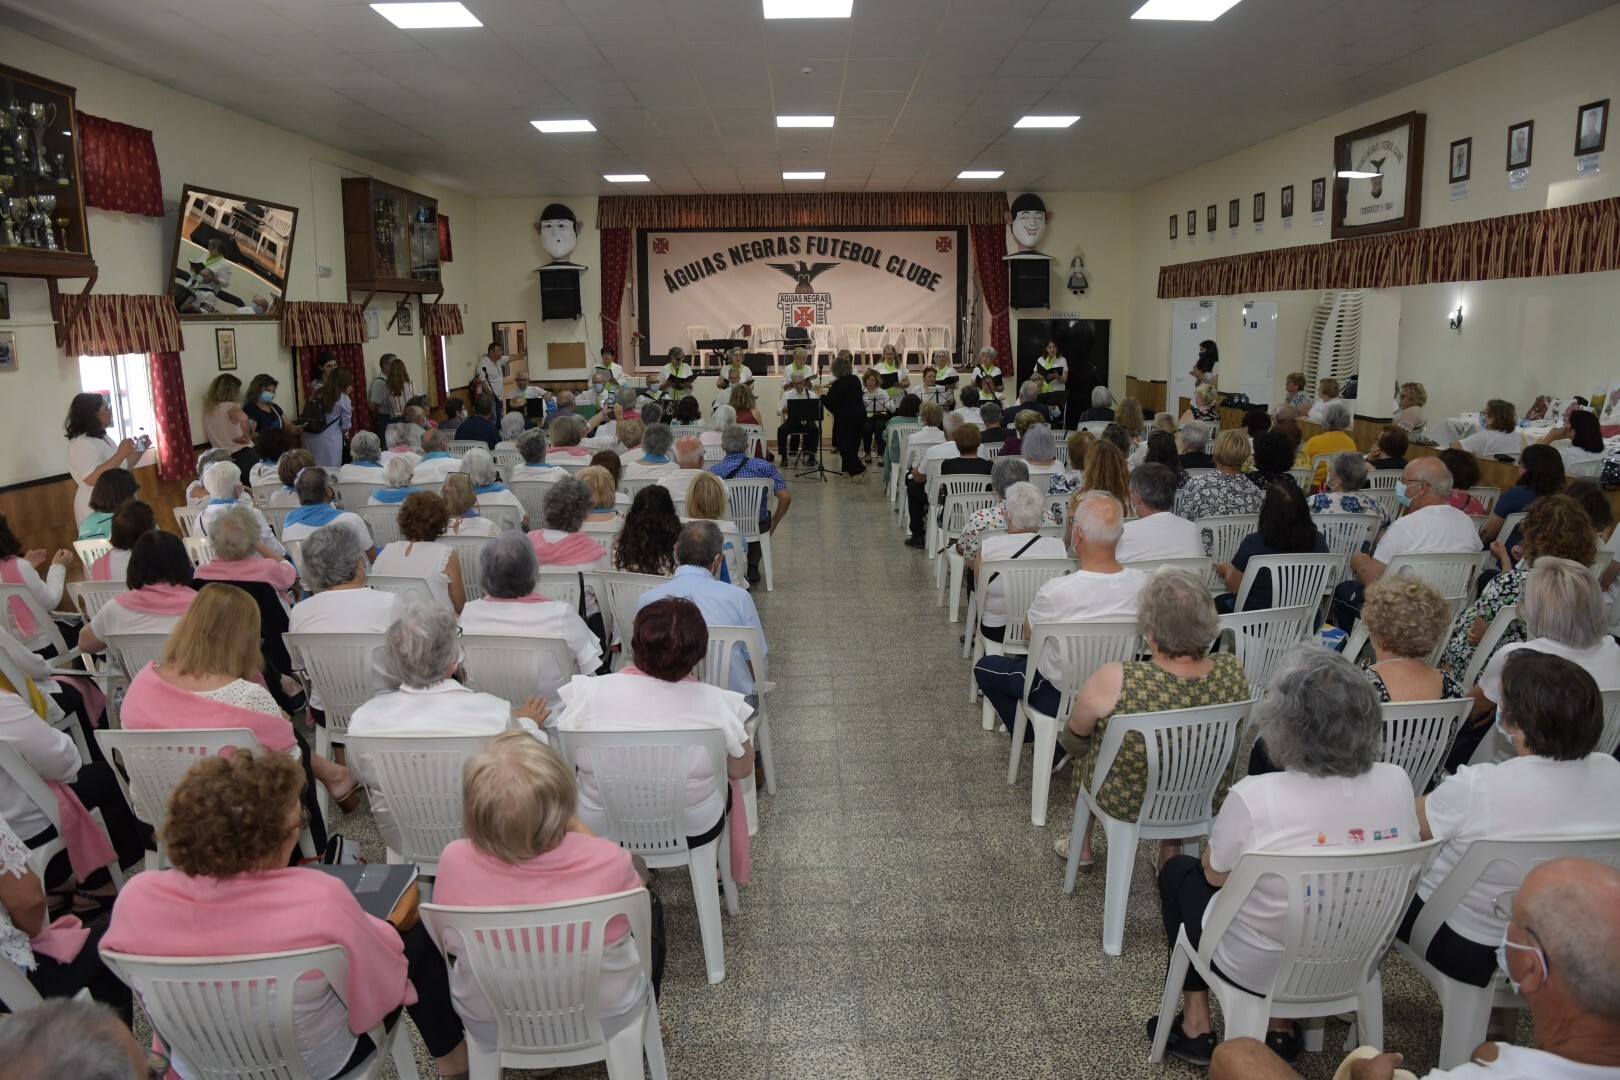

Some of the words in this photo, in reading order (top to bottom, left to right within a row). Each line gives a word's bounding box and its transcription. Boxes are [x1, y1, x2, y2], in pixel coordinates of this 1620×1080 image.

[664, 252, 727, 294] ÁGUIAS
[728, 235, 801, 267] NEGRAS
[806, 235, 882, 269] FUTEBOL
[886, 255, 943, 292] CLUBE
[803, 294, 829, 303] NEGRAS
